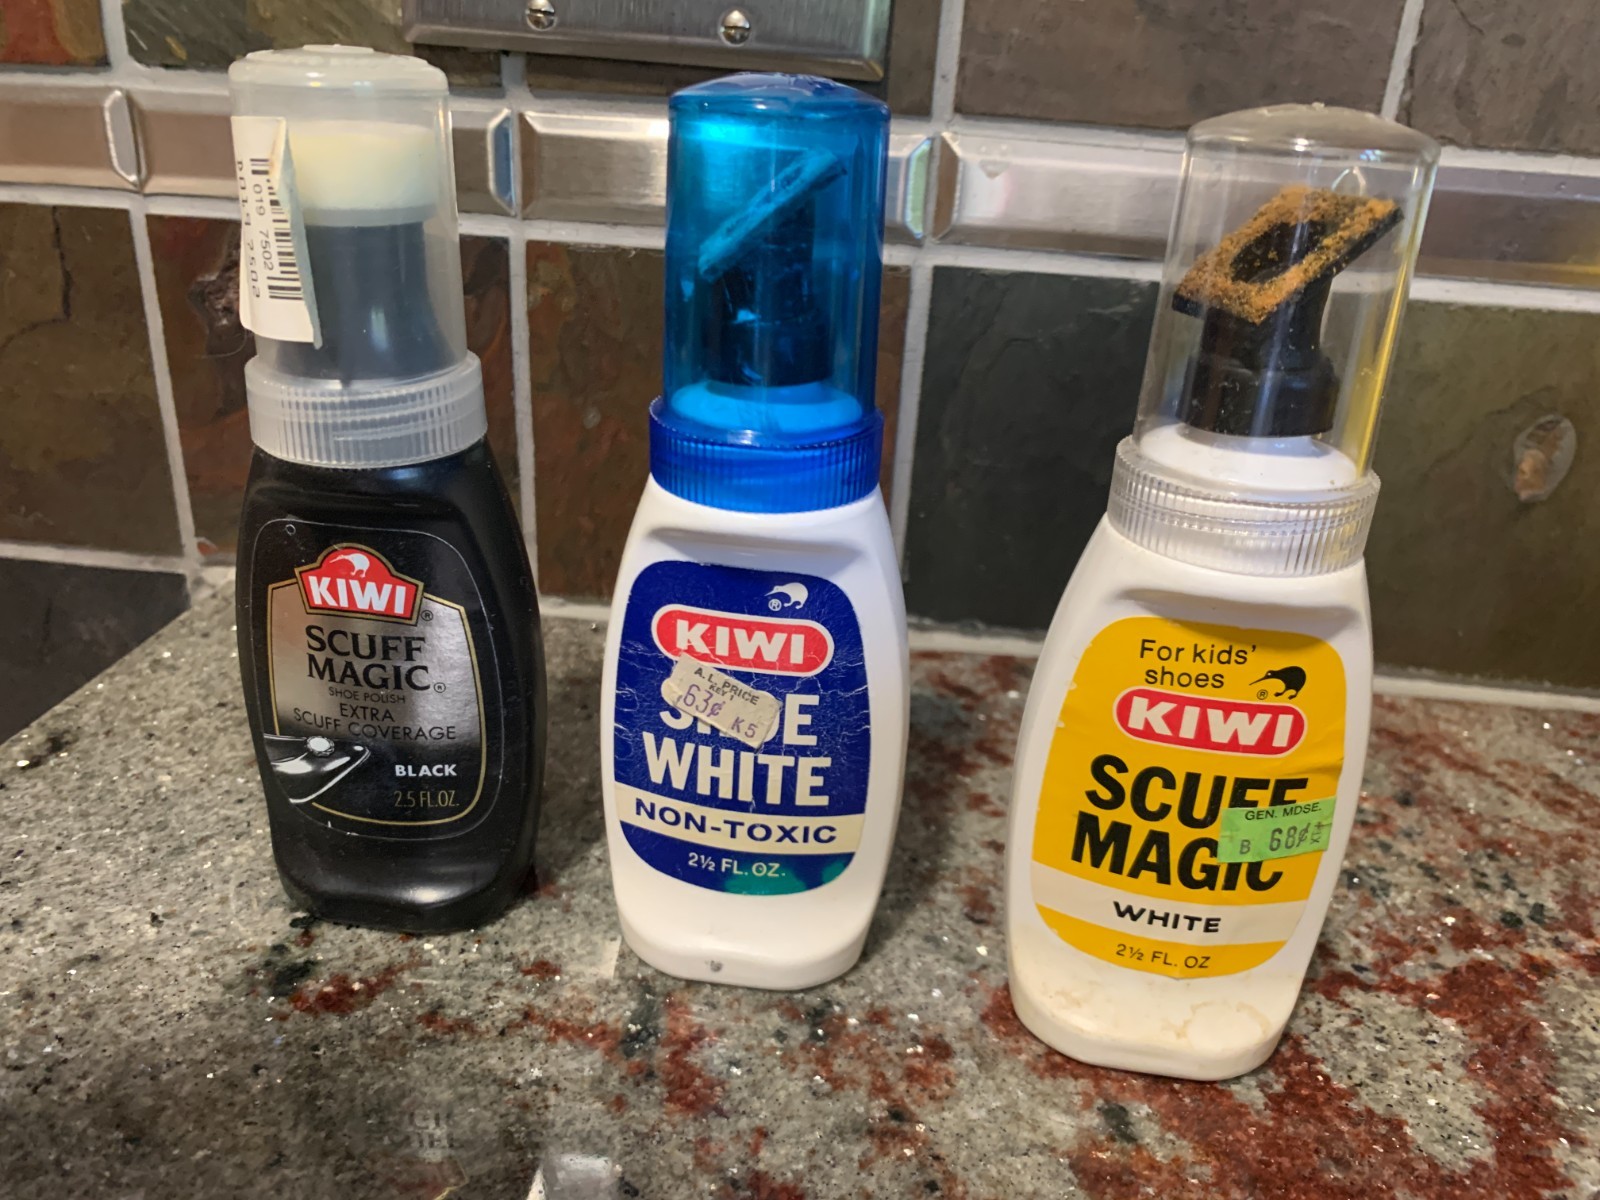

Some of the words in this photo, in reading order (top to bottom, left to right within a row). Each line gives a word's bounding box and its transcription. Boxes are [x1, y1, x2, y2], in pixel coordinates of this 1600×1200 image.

[252, 183, 266, 216] 019
[259, 229, 274, 271] 7502
[308, 575, 406, 614] KIWI
[305, 625, 426, 662] SCUFF
[676, 619, 805, 665] KIWI
[1140, 639, 1185, 662] For
[1193, 644, 1257, 665] kids'
[1145, 666, 1225, 688] shoes
[328, 686, 359, 701] SHOE
[364, 692, 406, 705] POLISH
[709, 685, 727, 697] KEY
[722, 681, 760, 706] PRICE
[293, 707, 341, 731] SCUFF
[348, 722, 457, 741] COVERAGE
[340, 703, 395, 722] EXTRA
[1127, 696, 1294, 748] KIWI
[395, 764, 458, 777] BLACK
[642, 731, 832, 807] WHITE
[394, 790, 416, 807] 2.5
[1245, 810, 1277, 821] GEN.
[1282, 802, 1322, 817] MDSE.
[635, 798, 837, 844] NON-TOXIC
[1239, 839, 1251, 855] B
[1269, 822, 1311, 852] 68¢
[721, 858, 748, 875] FL.
[752, 862, 786, 877] OZ.
[1113, 900, 1222, 933] WHITE
[1151, 951, 1177, 968] FL.
[1184, 955, 1211, 969] OZ
